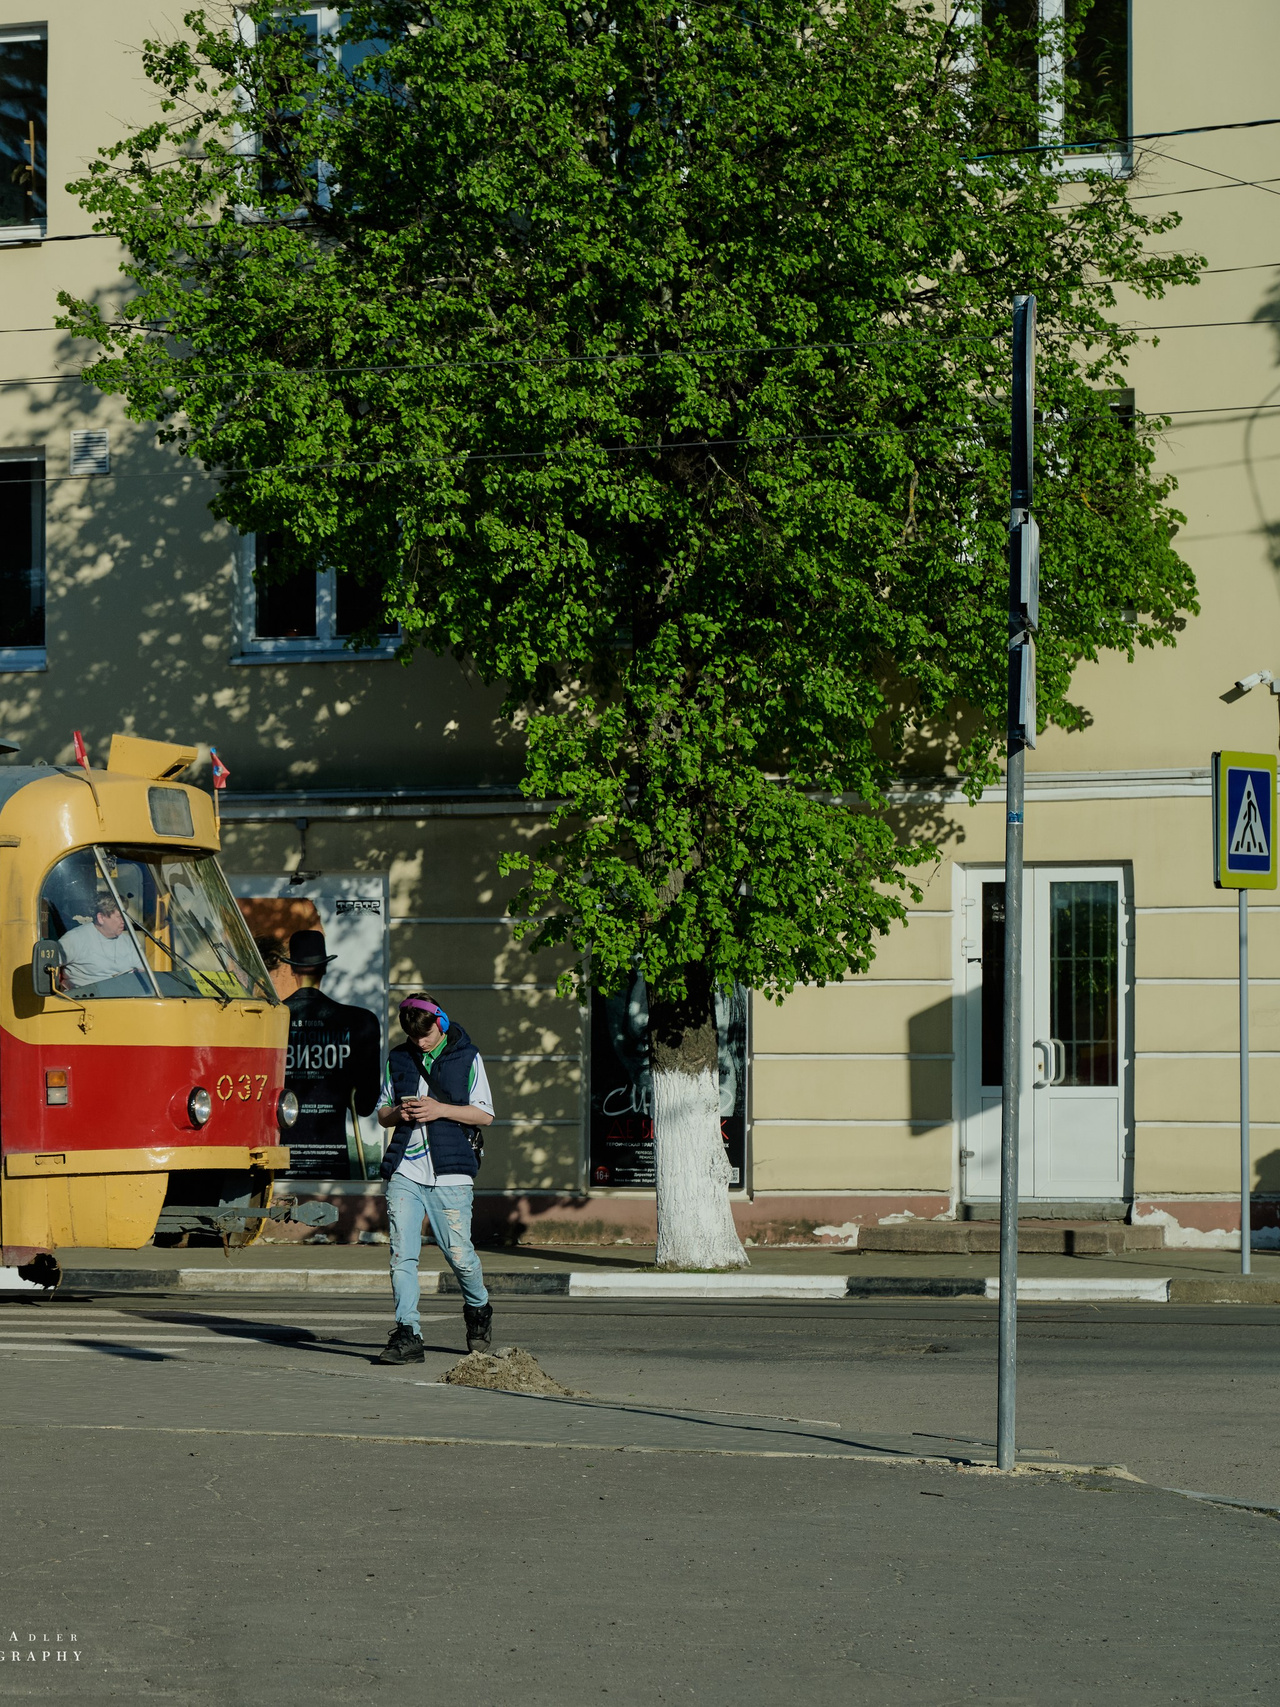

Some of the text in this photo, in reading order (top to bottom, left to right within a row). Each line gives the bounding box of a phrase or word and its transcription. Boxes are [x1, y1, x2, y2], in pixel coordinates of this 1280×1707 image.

[305, 1019, 325, 1028] ГОГОЛЬ
[290, 1027, 351, 1044] ТОЯЩИЙ
[286, 1044, 351, 1070] ВИЗОР
[216, 1074, 269, 1102] 037
[595, 1169, 610, 1181] 16+
